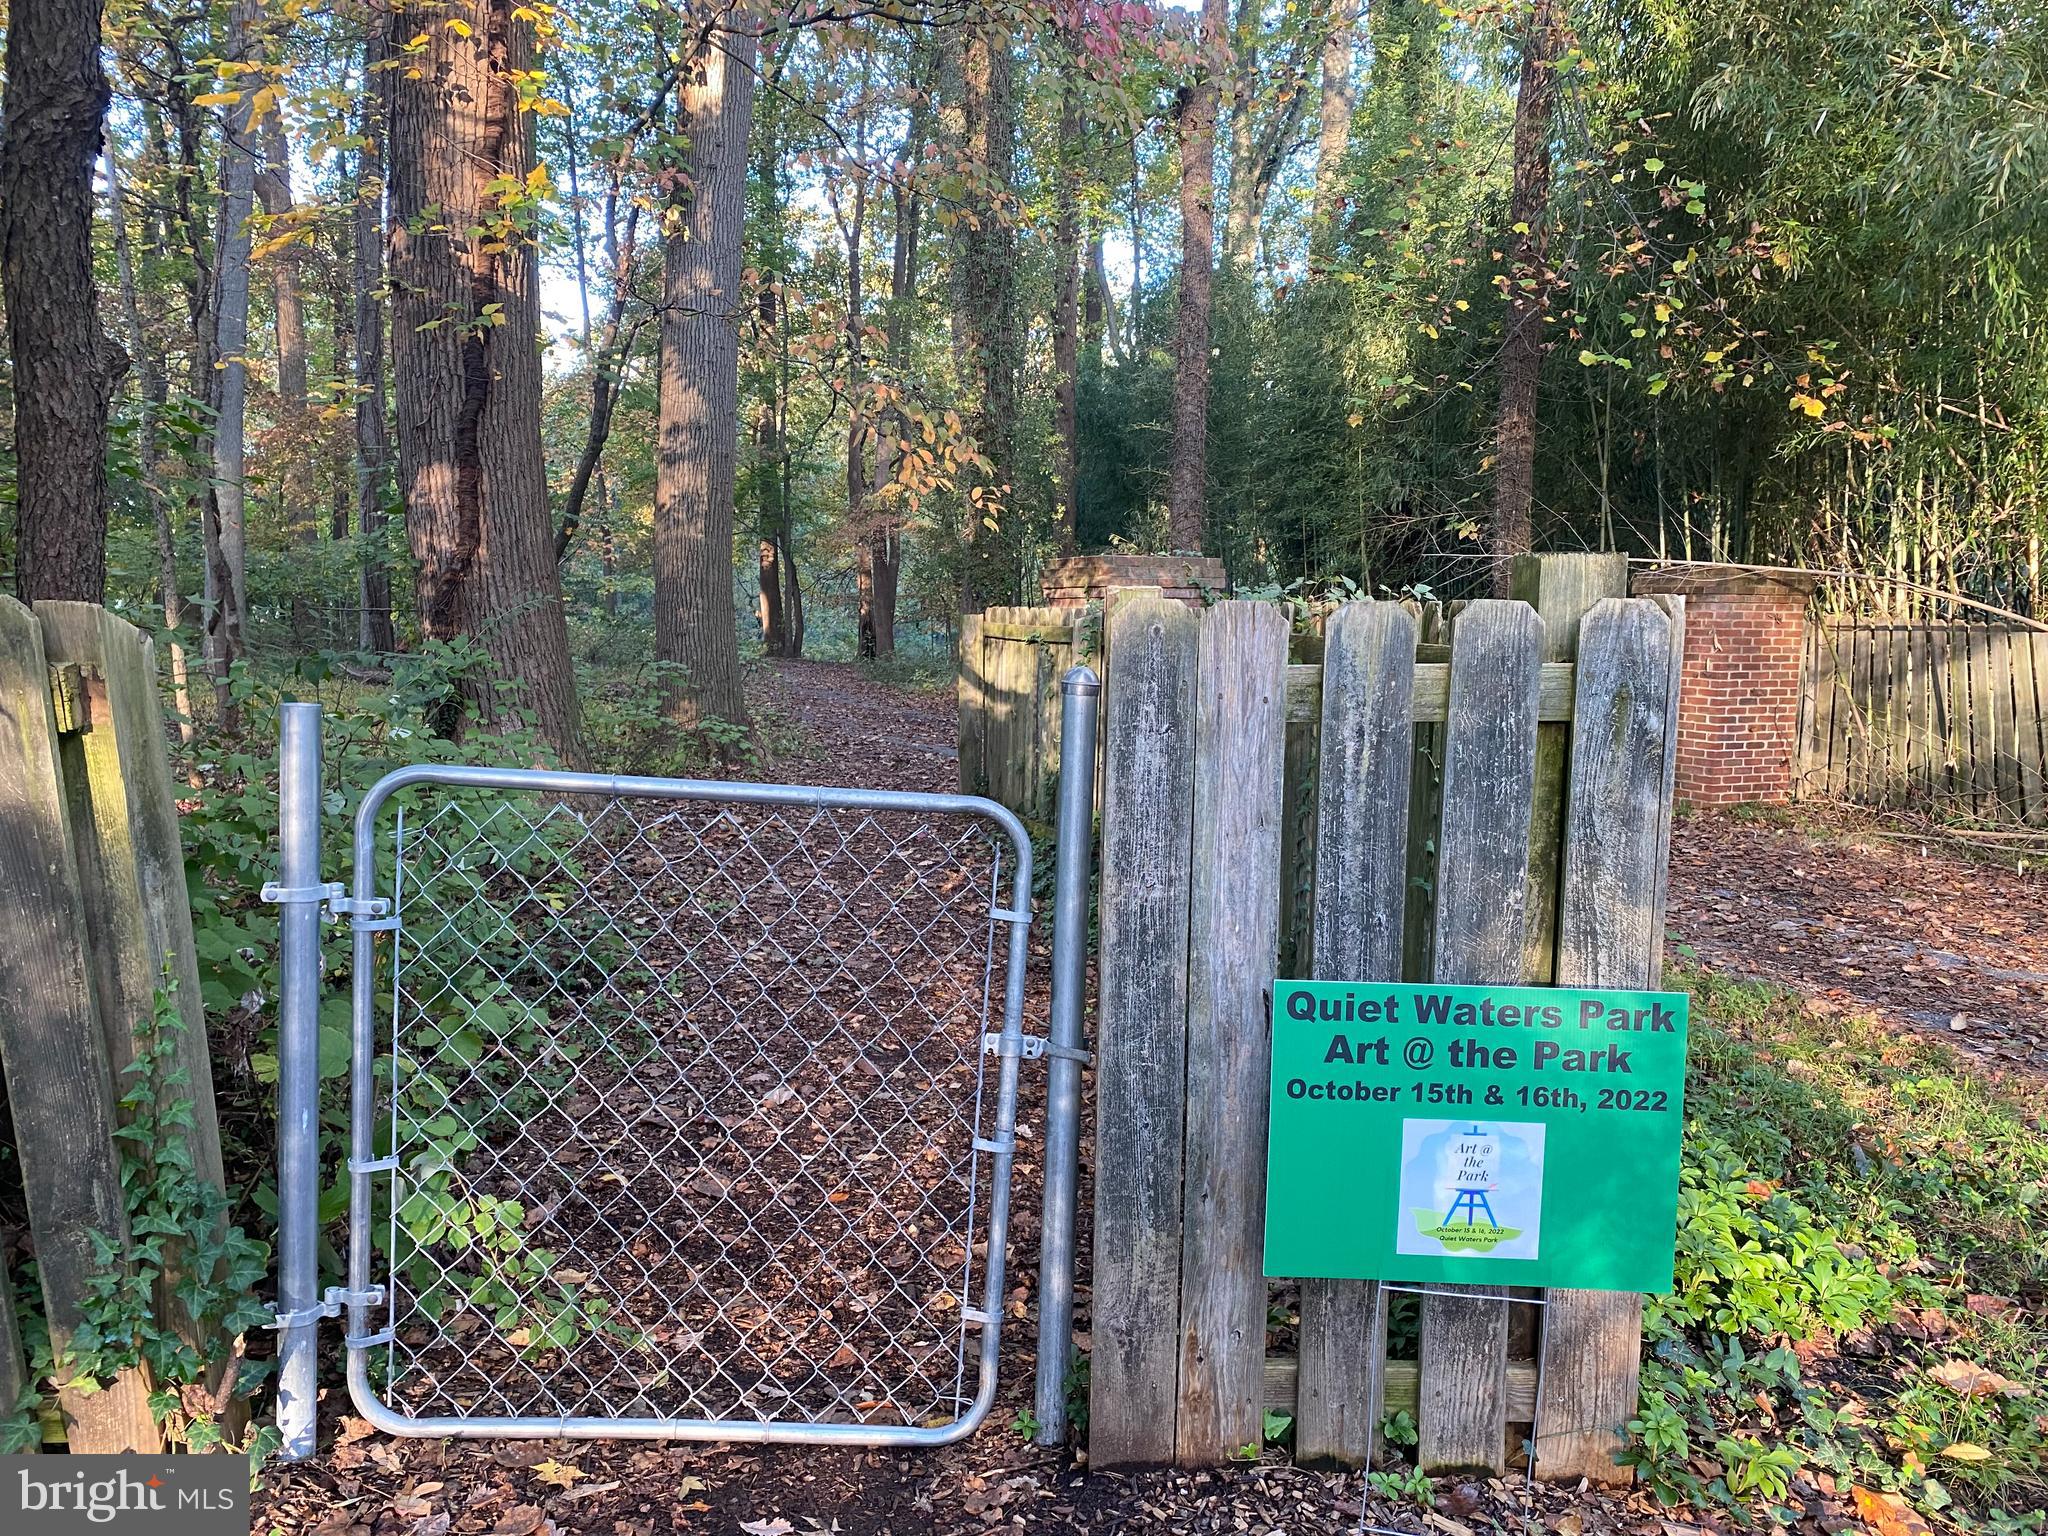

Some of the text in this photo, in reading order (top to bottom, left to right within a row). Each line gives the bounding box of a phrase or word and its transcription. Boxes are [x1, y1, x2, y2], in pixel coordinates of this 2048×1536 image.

[1286, 991, 1677, 1034] Quiet Waters Park
[1323, 1034, 1633, 1074] Art @ the Park
[1286, 1078, 1668, 1113] October 15th & 16th, 2022
[1454, 1143, 1493, 1156] Art @
[1464, 1156, 1484, 1168] the
[1456, 1170, 1489, 1182] Park
[1436, 1226, 1462, 1234] October
[1439, 1235, 1457, 1243] Quiet
